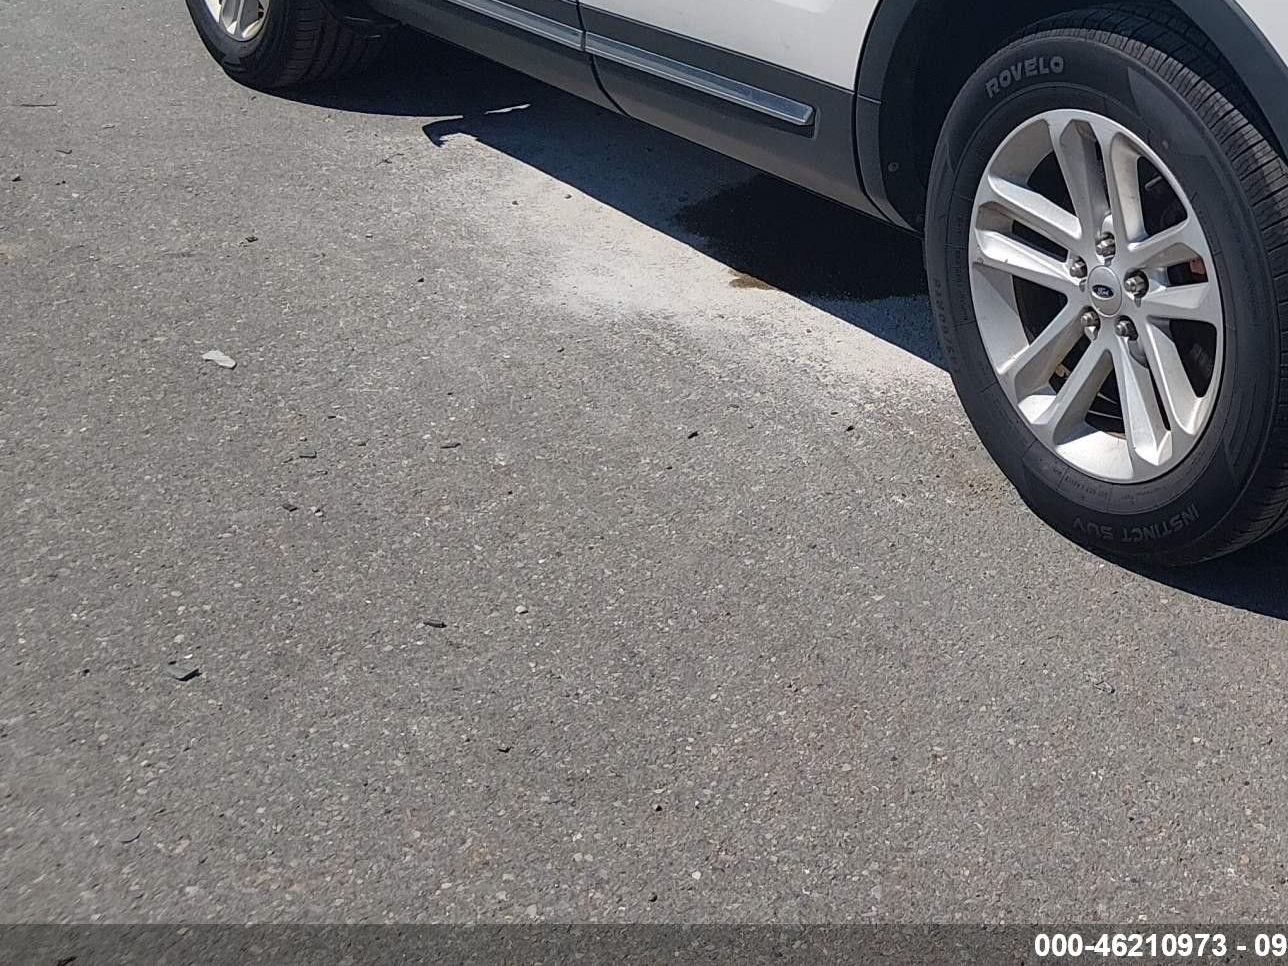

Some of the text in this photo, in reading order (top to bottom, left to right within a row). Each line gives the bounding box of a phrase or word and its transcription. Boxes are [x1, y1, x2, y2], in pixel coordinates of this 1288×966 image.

[985, 55, 1065, 99] ROVELO
[1072, 503, 1200, 543] INSTINCT SUV
